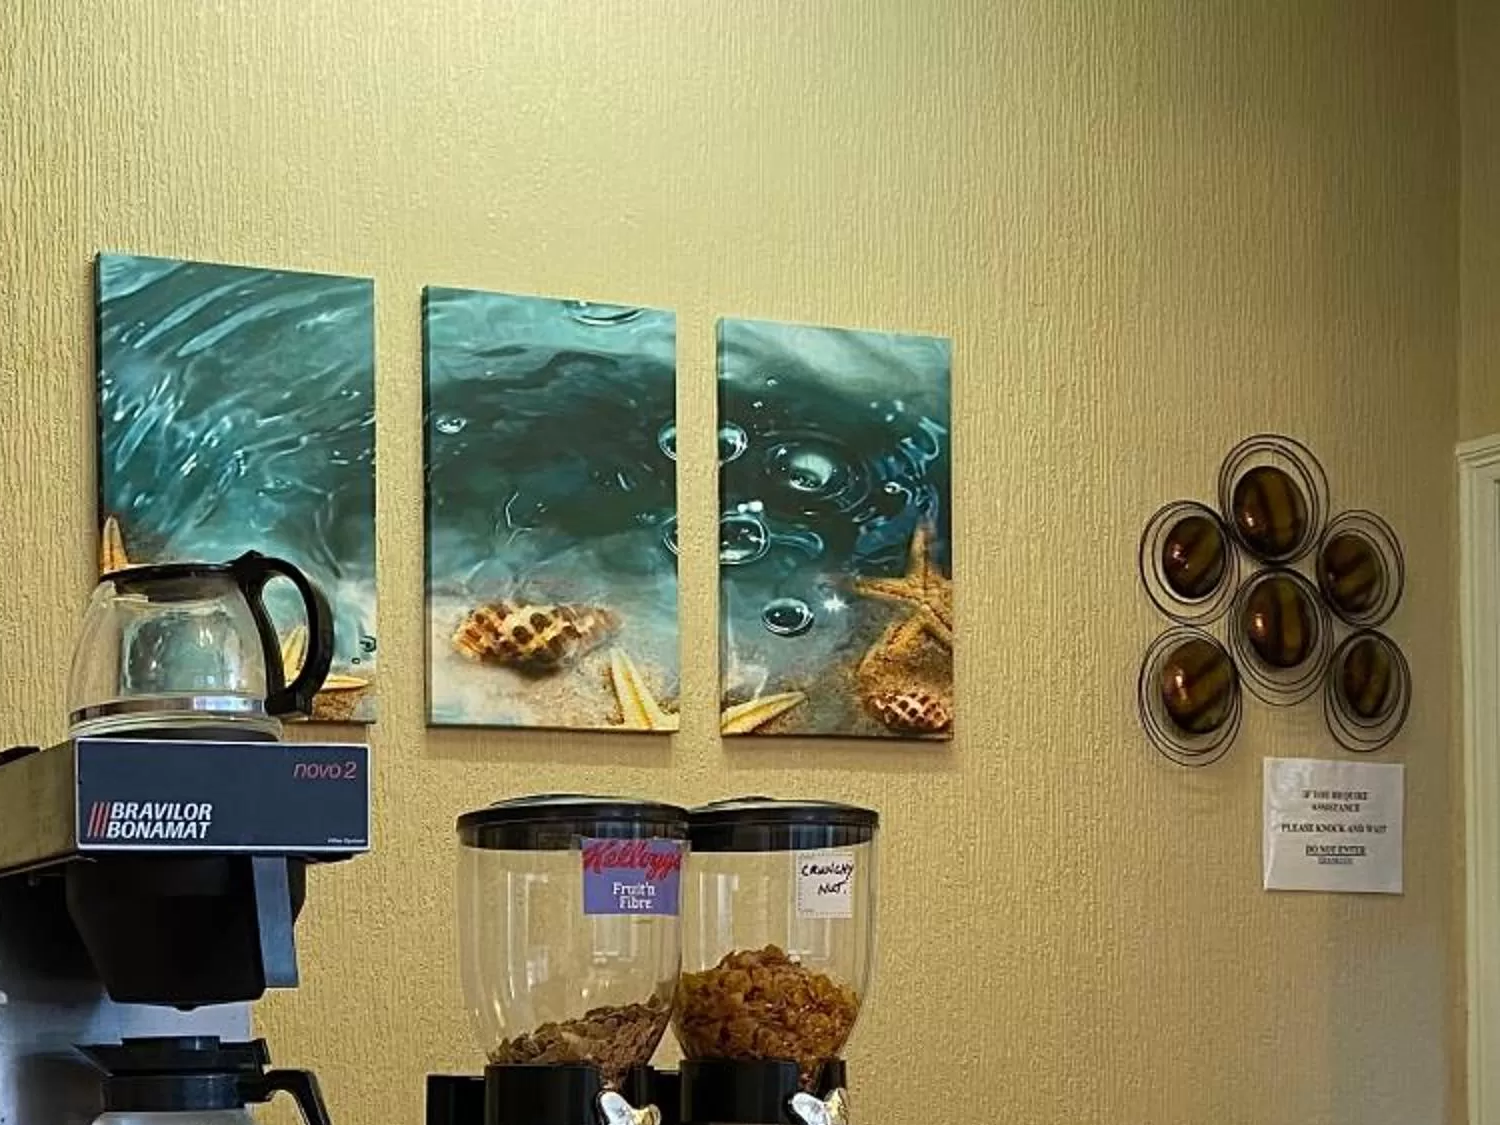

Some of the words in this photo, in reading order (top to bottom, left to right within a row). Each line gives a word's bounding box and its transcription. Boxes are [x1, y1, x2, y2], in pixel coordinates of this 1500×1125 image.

[293, 763, 341, 779] novo
[344, 761, 357, 779] 2
[110, 802, 212, 821] BRAVILOR
[106, 821, 211, 840] BONAMAT
